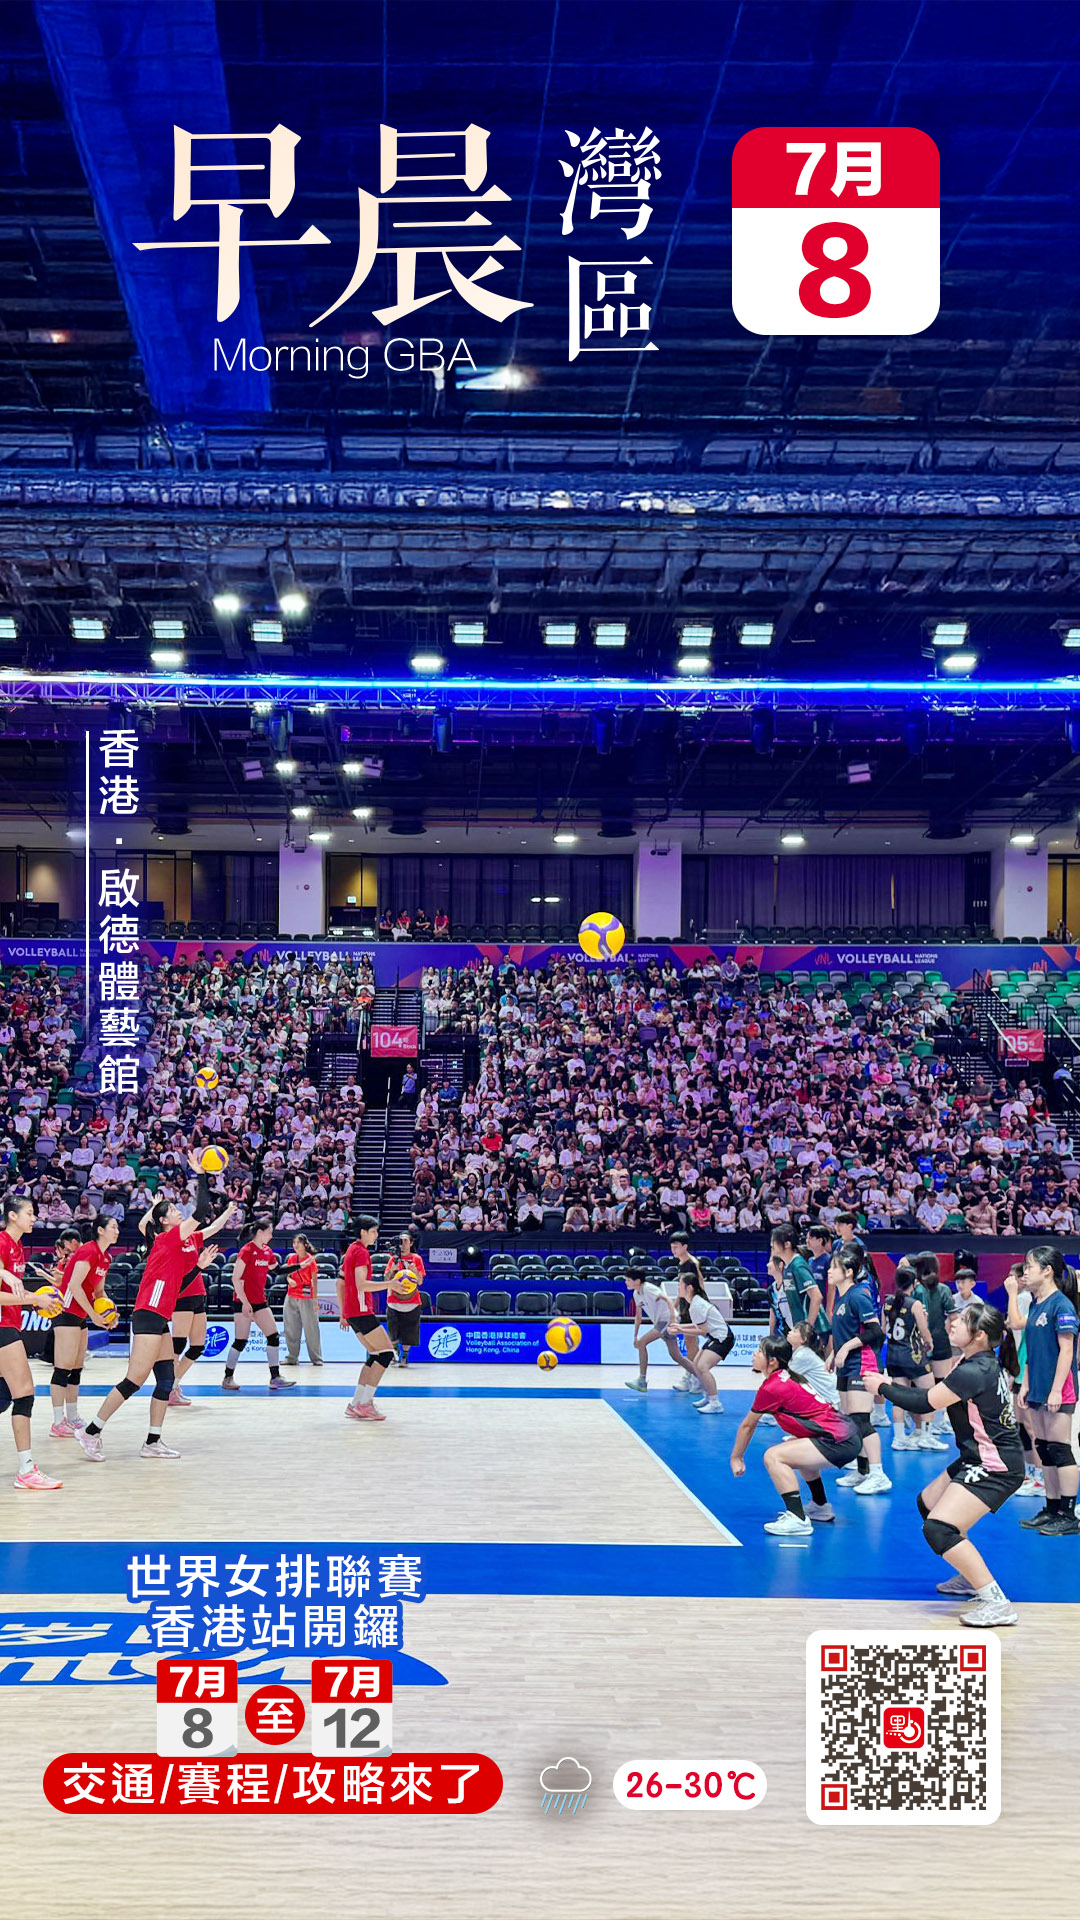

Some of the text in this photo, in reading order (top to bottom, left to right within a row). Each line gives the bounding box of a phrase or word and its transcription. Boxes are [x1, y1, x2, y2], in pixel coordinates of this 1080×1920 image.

[8, 947, 78, 957] VOLLEYBALL
[836, 953, 914, 964] VOLLEYBALL
[372, 1031, 403, 1049] 104
[532, 1339, 540, 1347] of
[465, 1347, 483, 1355] Hong
